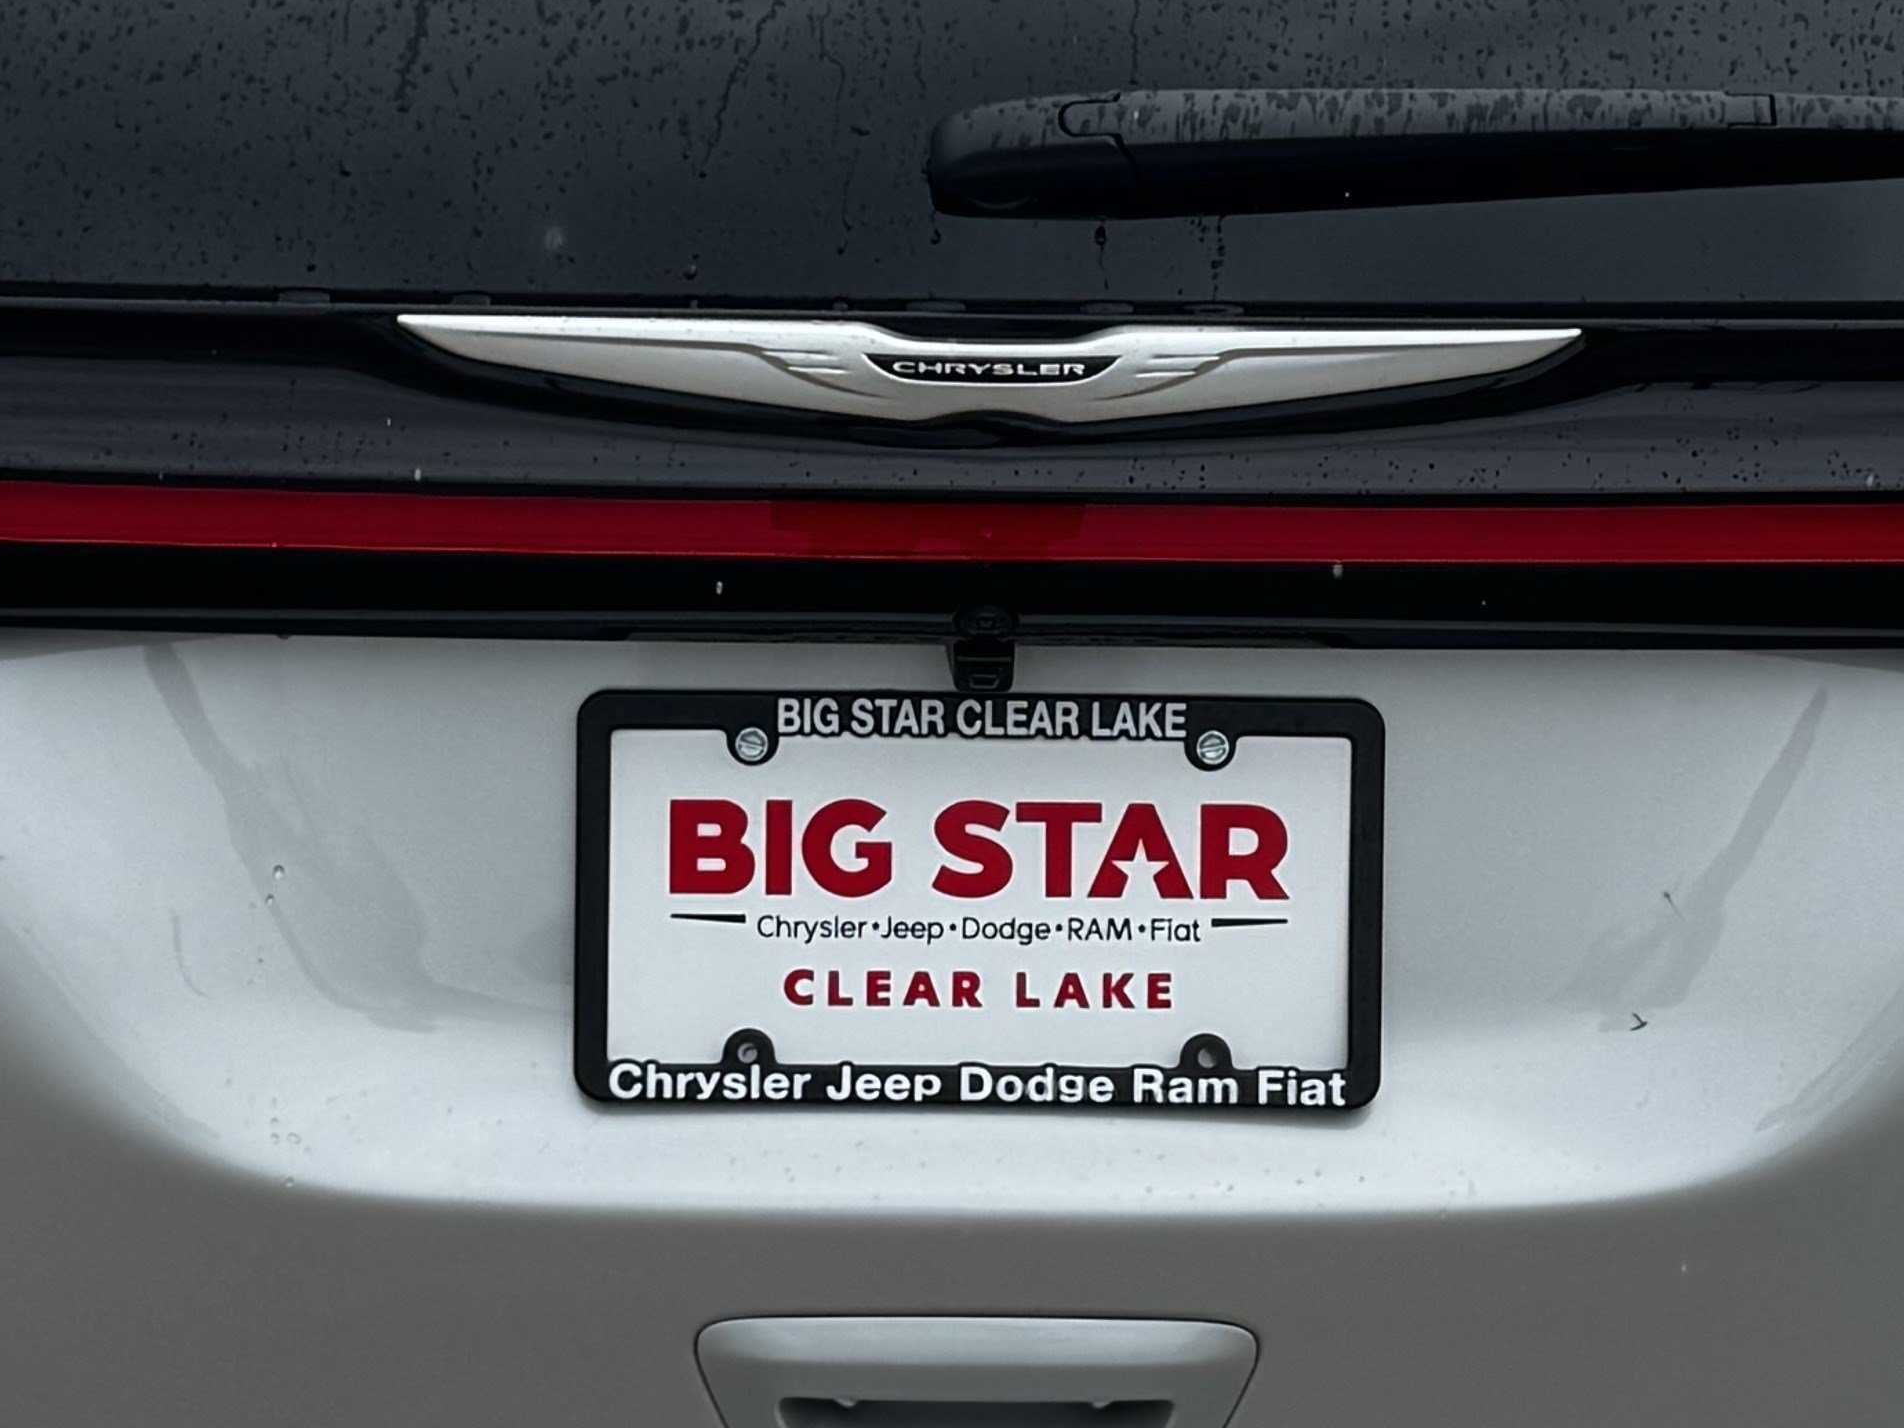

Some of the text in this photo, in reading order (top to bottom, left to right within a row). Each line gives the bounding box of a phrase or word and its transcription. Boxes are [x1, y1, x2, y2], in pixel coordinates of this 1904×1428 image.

[892, 360, 1086, 376] CHRYSLER
[777, 697, 1187, 739] BIG STAR CLEAR LAKE
[669, 799, 1289, 900] BIG STAR
[757, 914, 1201, 946] Chrysler Jeep Dodge RAM Fiat
[783, 969, 1173, 1009] CLEAR LAKE
[608, 1062, 1347, 1107] Chrysler Jeep Dodge Ram Fiat
